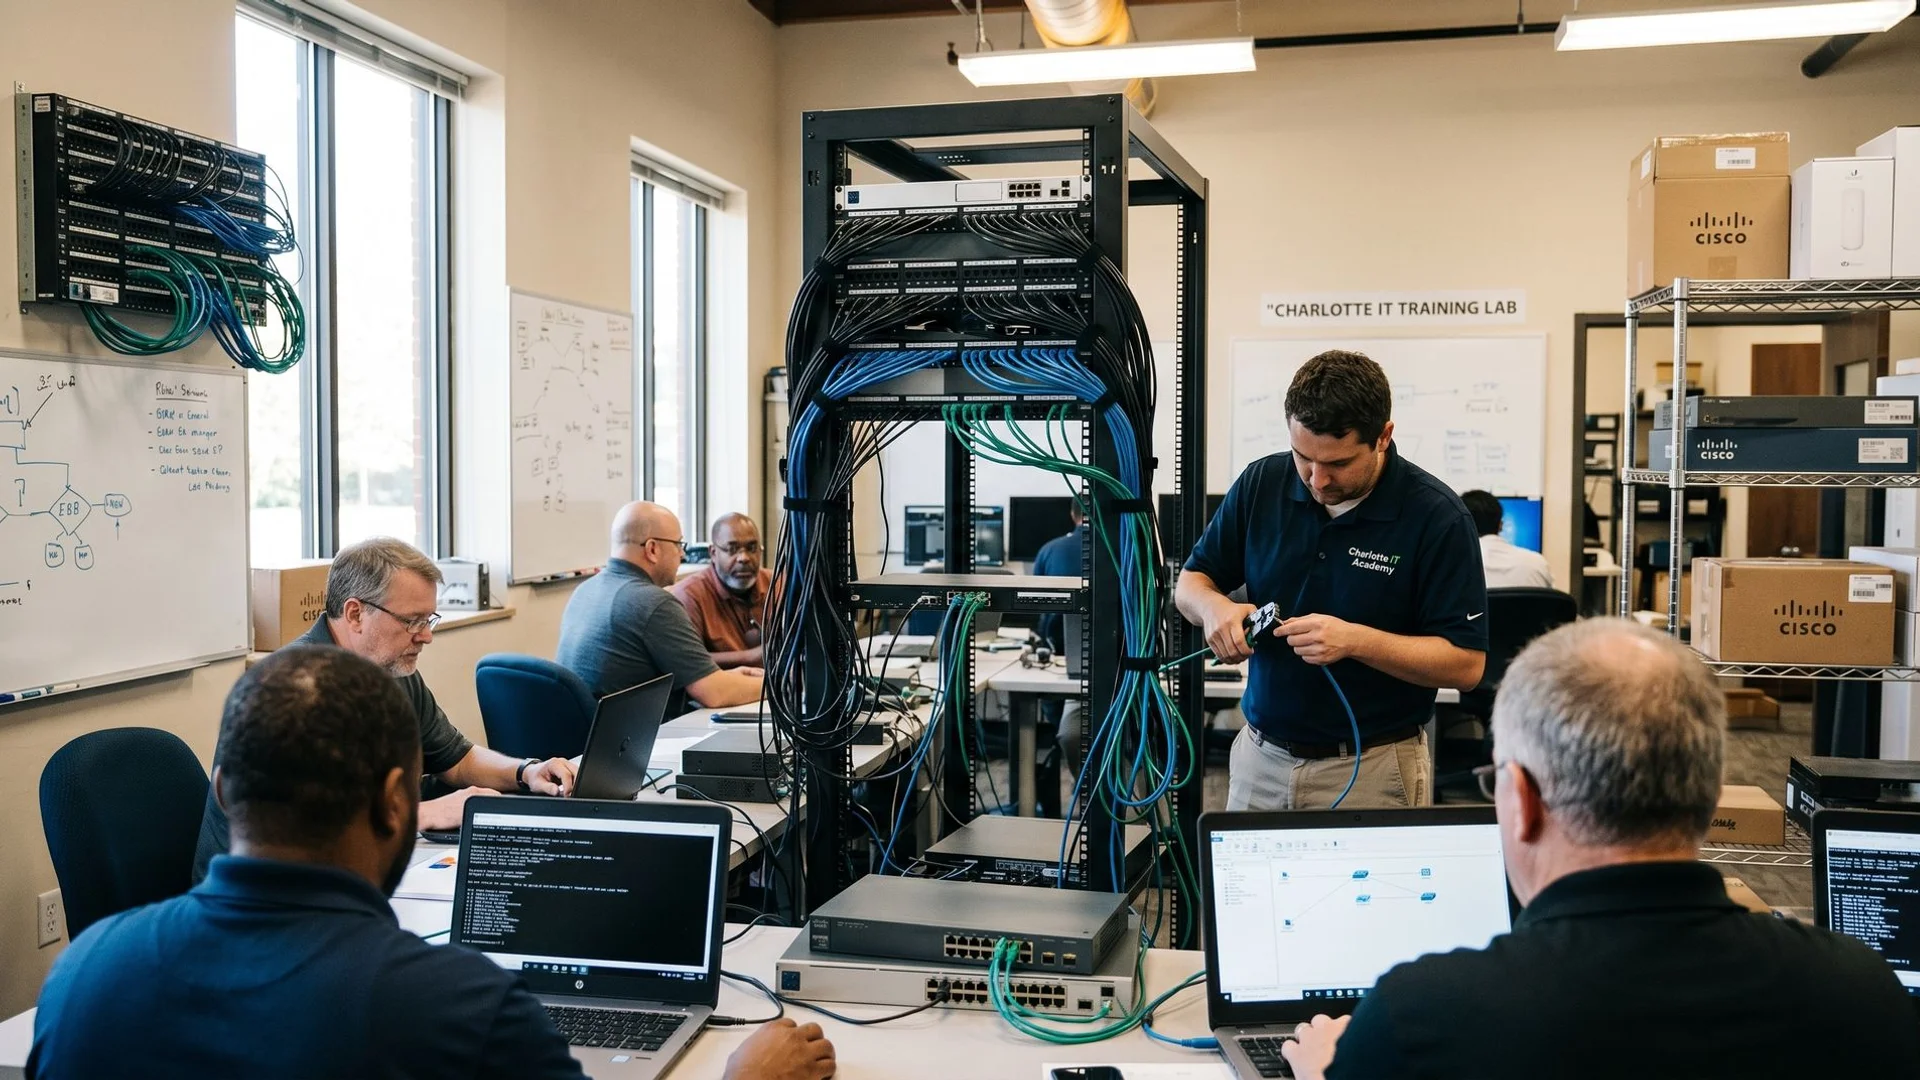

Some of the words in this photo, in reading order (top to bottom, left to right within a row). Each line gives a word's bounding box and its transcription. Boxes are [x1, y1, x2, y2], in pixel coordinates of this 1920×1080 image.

[1695, 232, 1747, 245] CISCO
[1378, 302, 1393, 316] IT
[1398, 301, 1479, 315] TRAINING
[1484, 300, 1518, 315] LAB
[1700, 451, 1735, 460] CISCO
[1348, 546, 1389, 563] Charlotte
[1389, 555, 1401, 565] IT
[1351, 558, 1395, 576] Academy
[1779, 622, 1837, 636] CISCO
